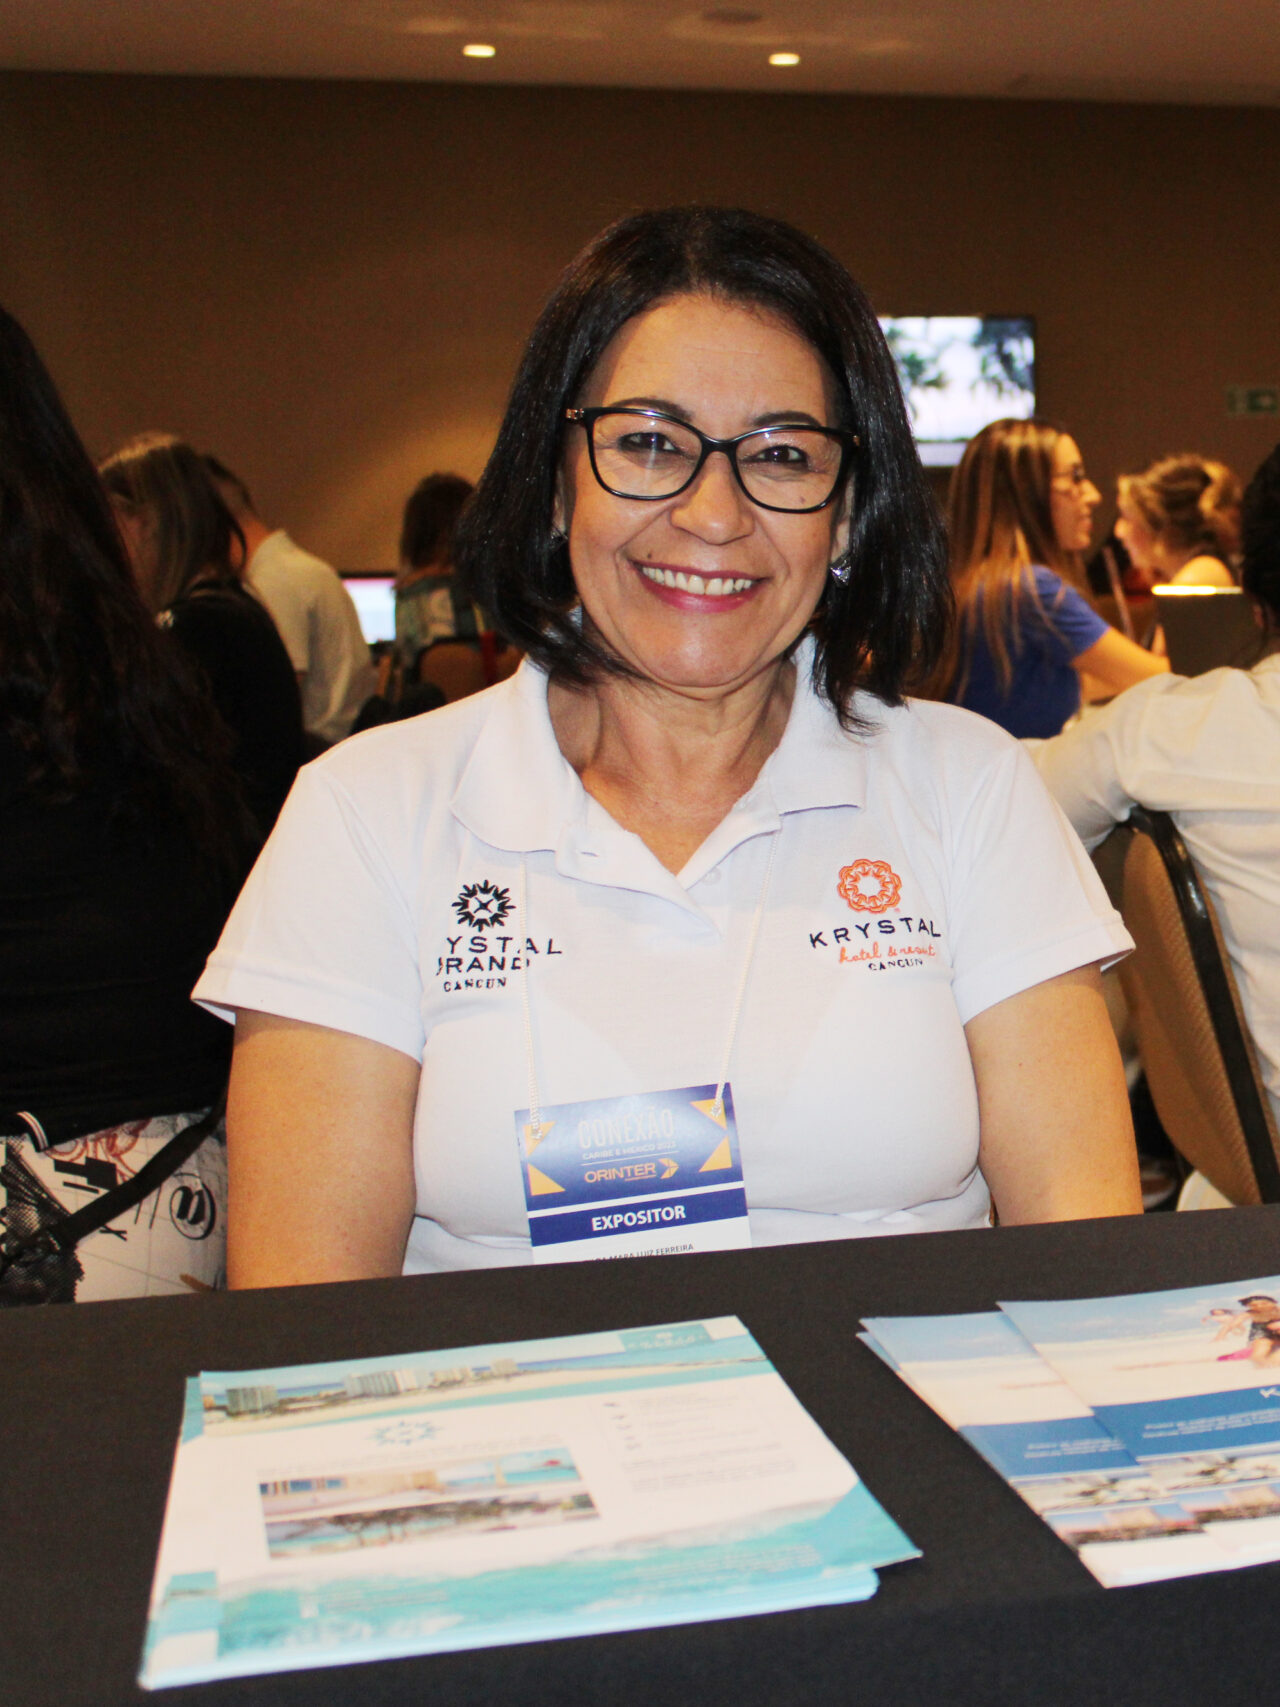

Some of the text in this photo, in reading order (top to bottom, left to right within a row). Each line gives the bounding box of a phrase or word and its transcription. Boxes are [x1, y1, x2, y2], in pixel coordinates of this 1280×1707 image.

[809, 917, 941, 948] KRYSTAL
[446, 936, 562, 954] YSTAL
[579, 1105, 675, 1149] CONEXÃO
[584, 1162, 657, 1183] ORINTER
[591, 1205, 686, 1232] EXPOSITOR
[655, 1243, 695, 1256] FERREIRA
